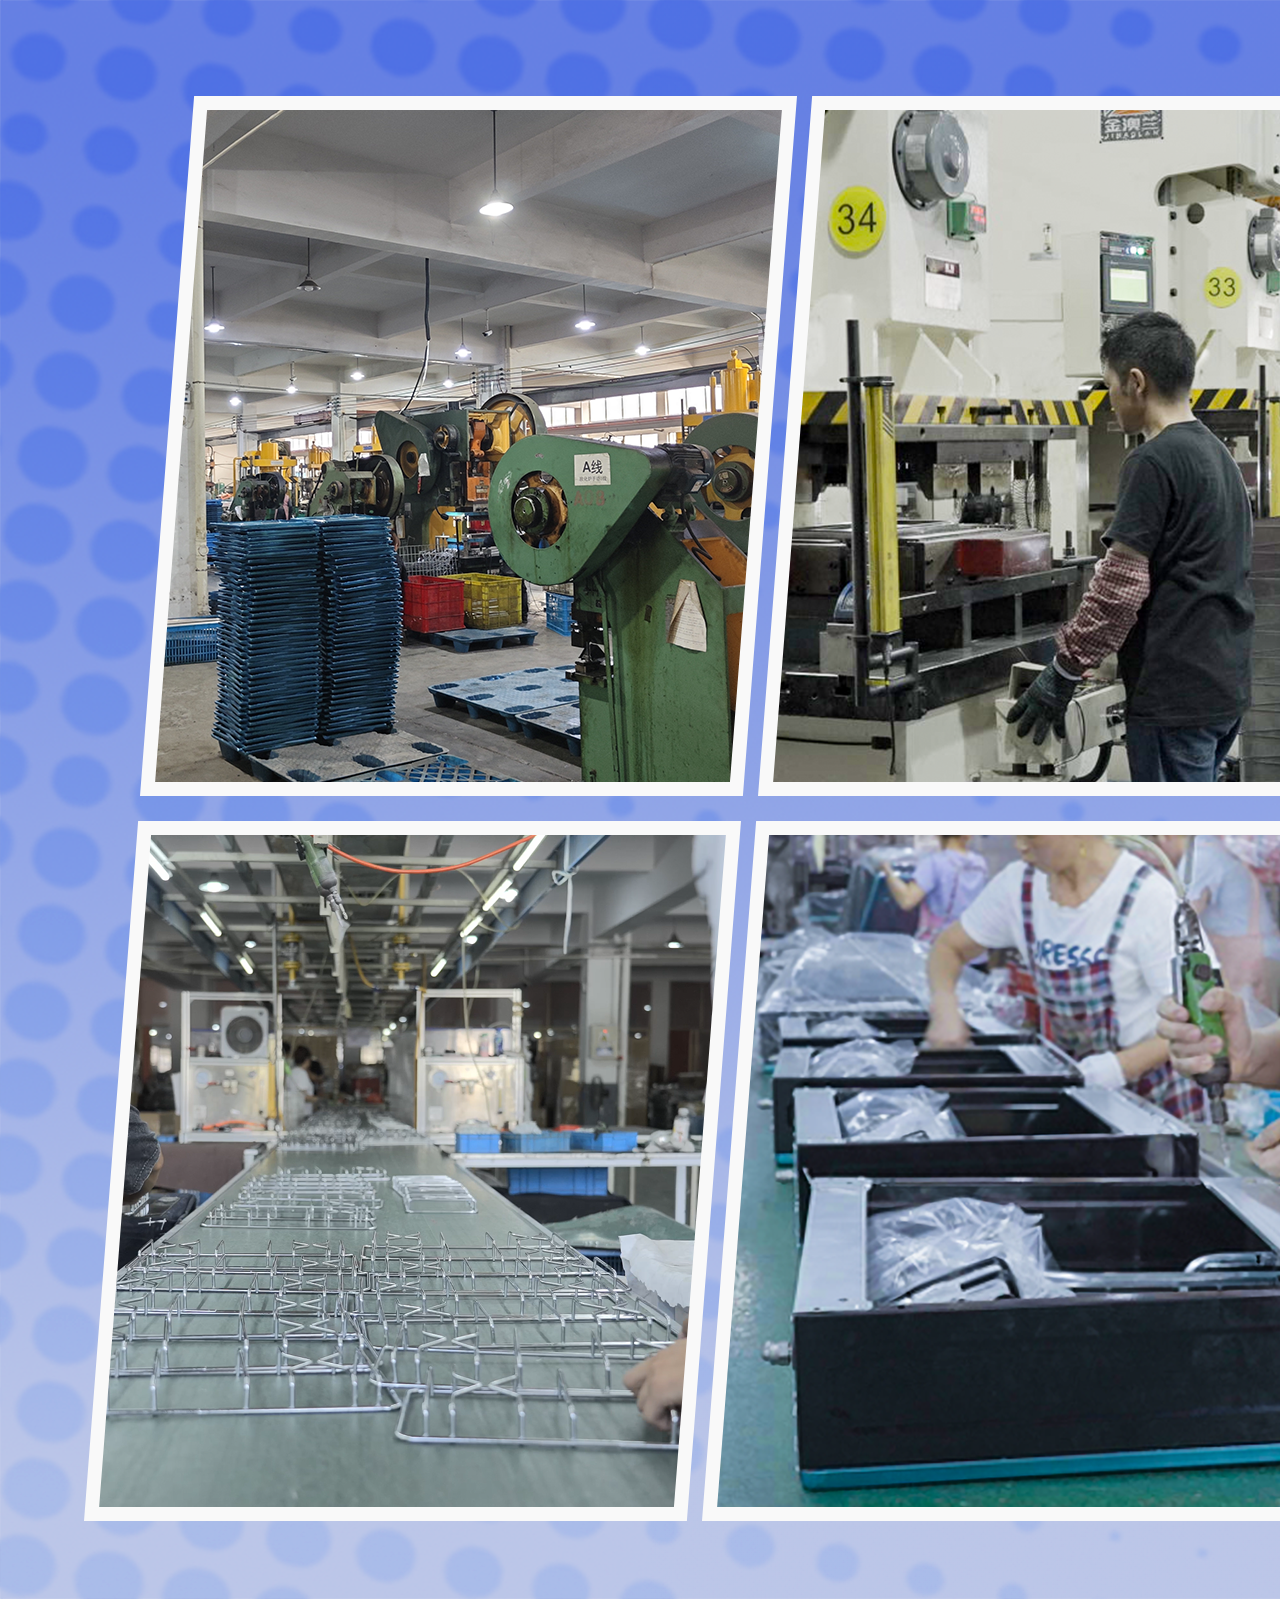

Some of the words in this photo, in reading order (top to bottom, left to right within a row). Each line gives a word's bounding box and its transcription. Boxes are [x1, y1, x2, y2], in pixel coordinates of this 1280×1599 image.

[837, 202, 877, 235] 34
[1208, 277, 1236, 297] 33
[582, 459, 604, 474] A线
